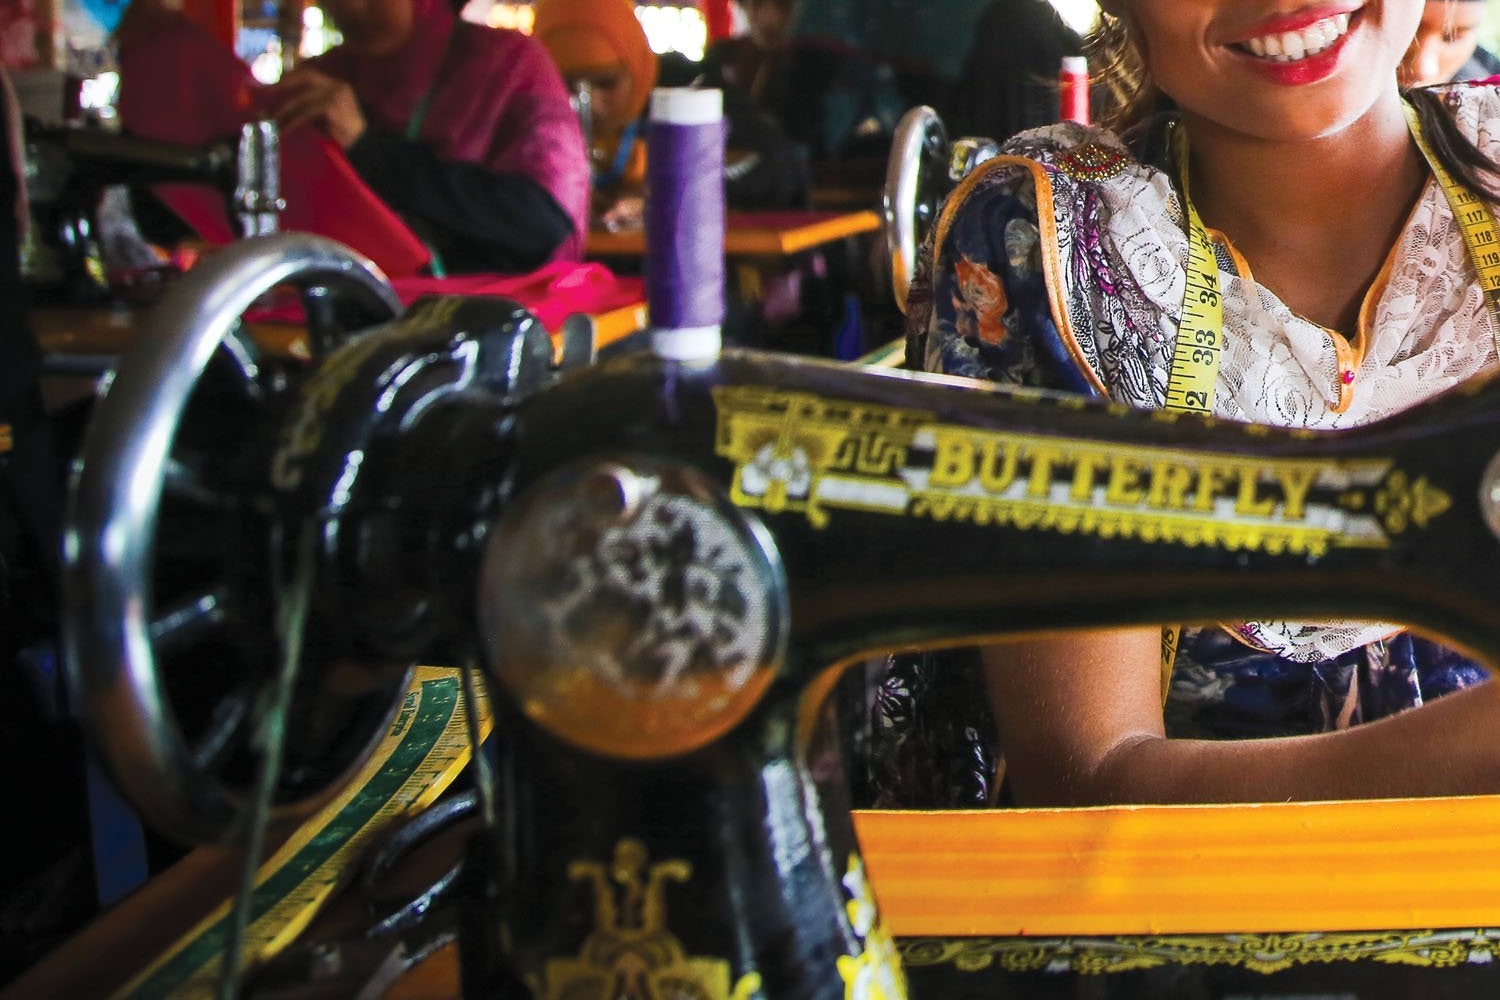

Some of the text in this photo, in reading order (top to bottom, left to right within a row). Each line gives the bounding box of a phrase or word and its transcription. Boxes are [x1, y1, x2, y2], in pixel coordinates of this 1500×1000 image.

[1466, 210, 1484, 223] 117
[1474, 231, 1493, 244] 118
[1482, 252, 1500, 266] 119
[1199, 272, 1218, 308] 34
[1192, 329, 1216, 366] 33
[928, 437, 1321, 519] BUTTERFLY
